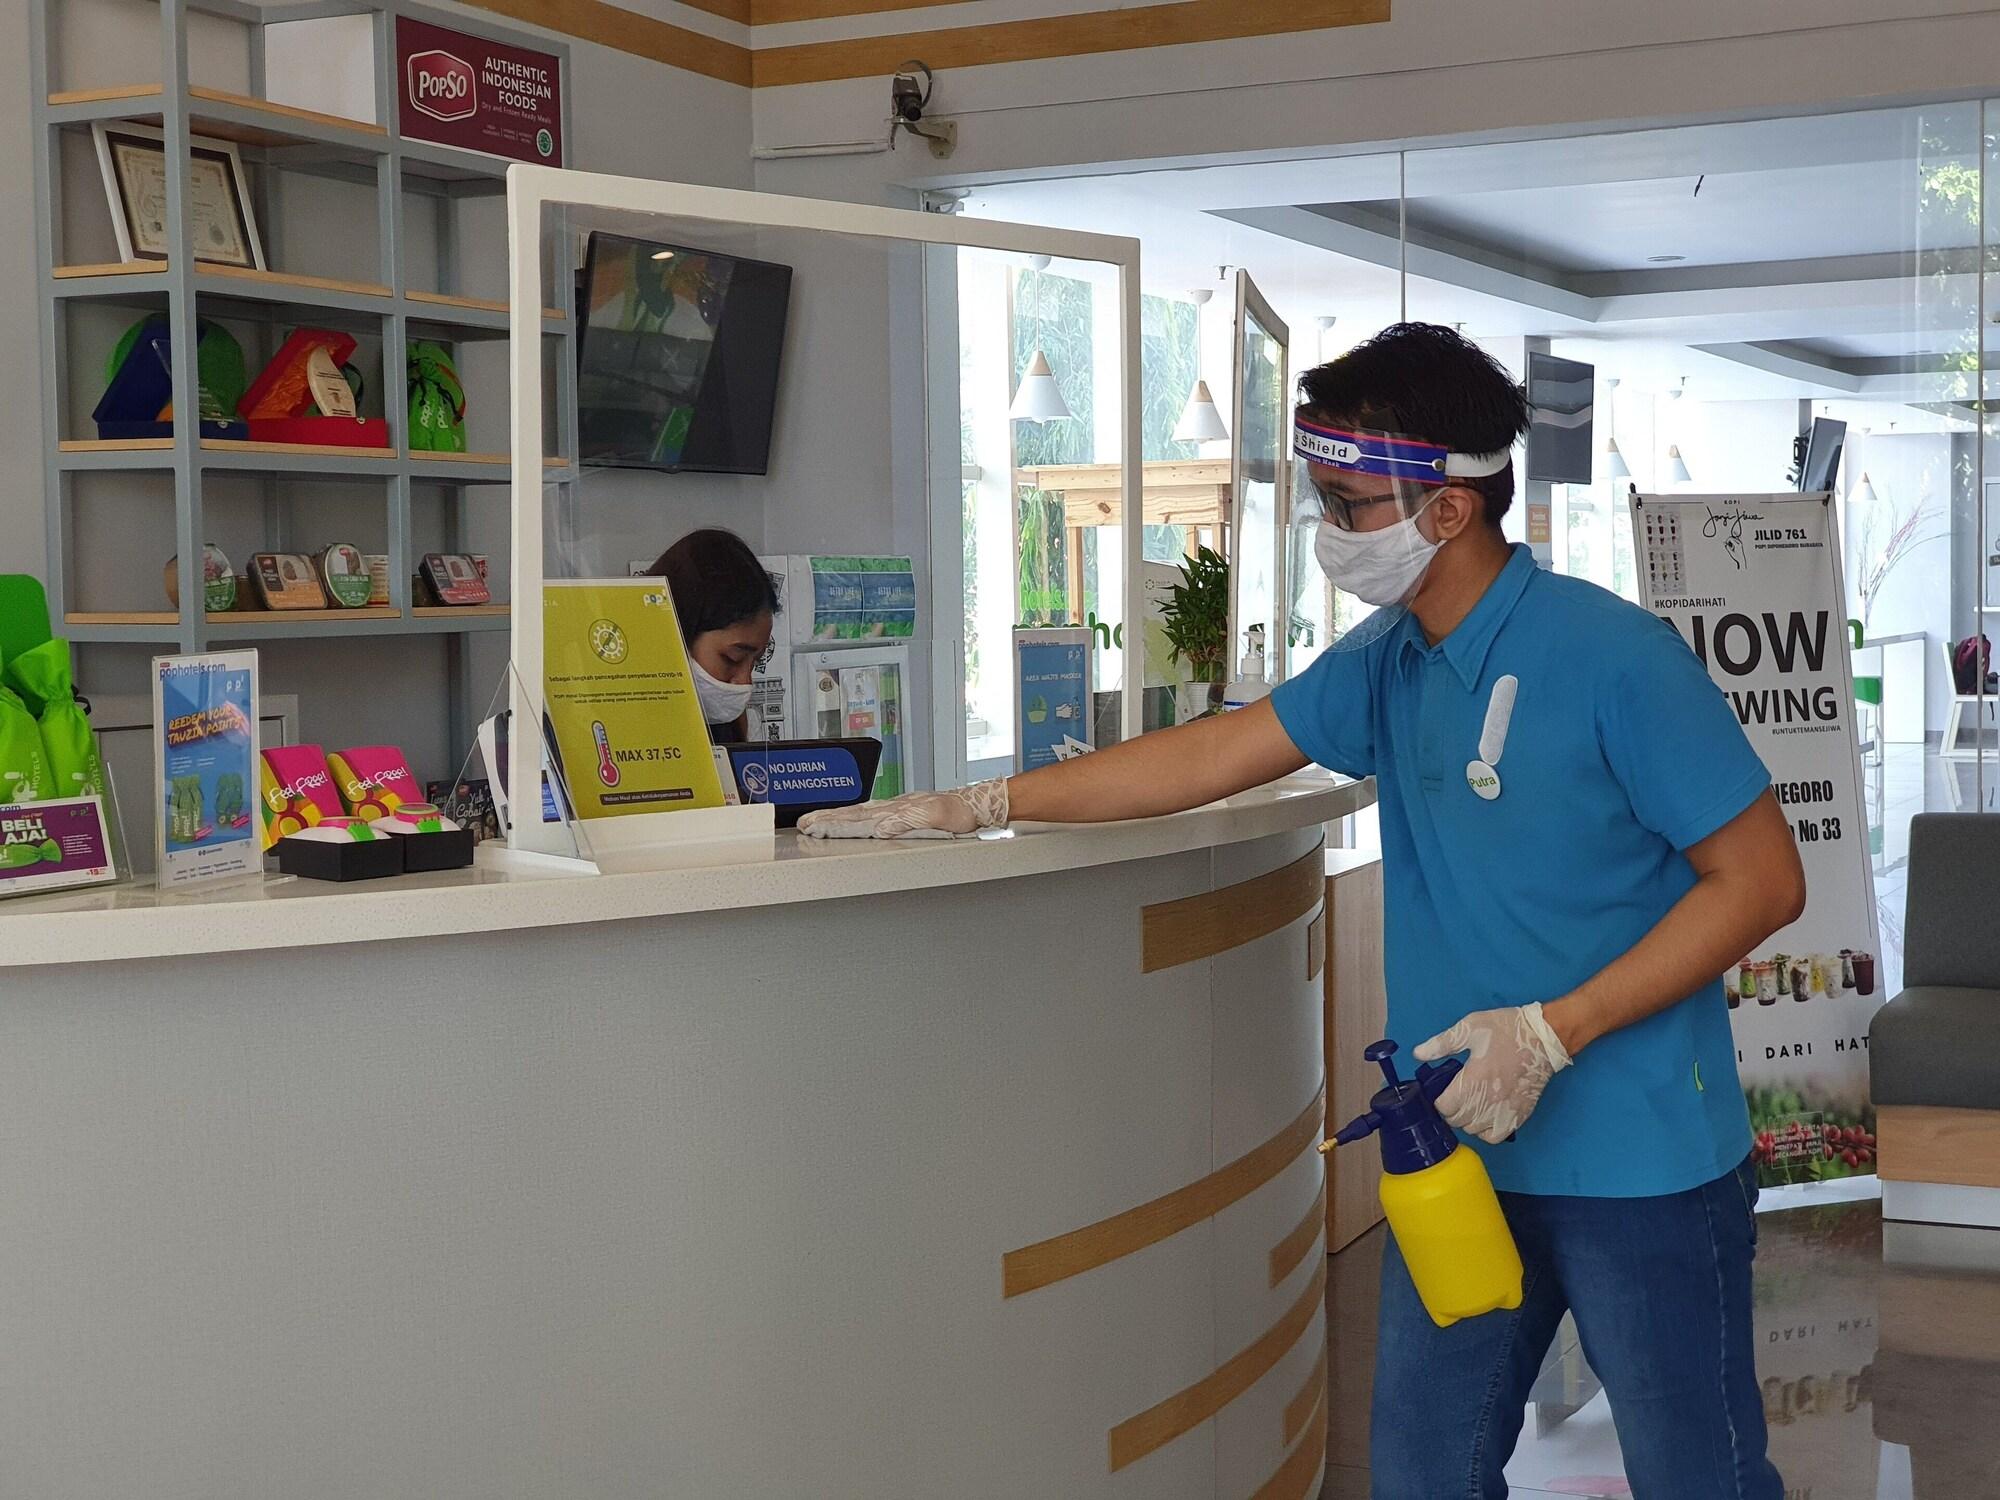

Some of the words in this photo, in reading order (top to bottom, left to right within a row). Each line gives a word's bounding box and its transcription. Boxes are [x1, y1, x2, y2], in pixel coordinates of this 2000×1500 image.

[485, 56, 548, 83] AUTHENTIC
[482, 70, 552, 99] INDONESIAN
[499, 90, 537, 111] FOODS
[1301, 435, 1348, 458] Shield
[1754, 529, 1782, 541] JILID
[1785, 528, 1808, 540] 761
[1654, 597, 1727, 609] #KOPIDARIHATI
[1659, 610, 1830, 681] NOW
[160, 662, 226, 682] pophotels.com
[1772, 724, 1842, 736] #UNTUKTEMANSEJIWA
[615, 749, 645, 763] MAX
[768, 763, 785, 774] NO
[786, 761, 826, 774] DURIAN
[347, 776, 374, 796] Feel
[773, 780, 783, 791] &
[783, 776, 855, 790] MANGOSTEEN
[1468, 775, 1497, 789] Putra
[269, 784, 297, 805] Feel
[0, 818, 43, 833] BELI
[1797, 819, 1819, 843] No
[1821, 816, 1842, 841] 33
[4, 829, 48, 845] AJA!
[1765, 1042, 1813, 1060] DARI
